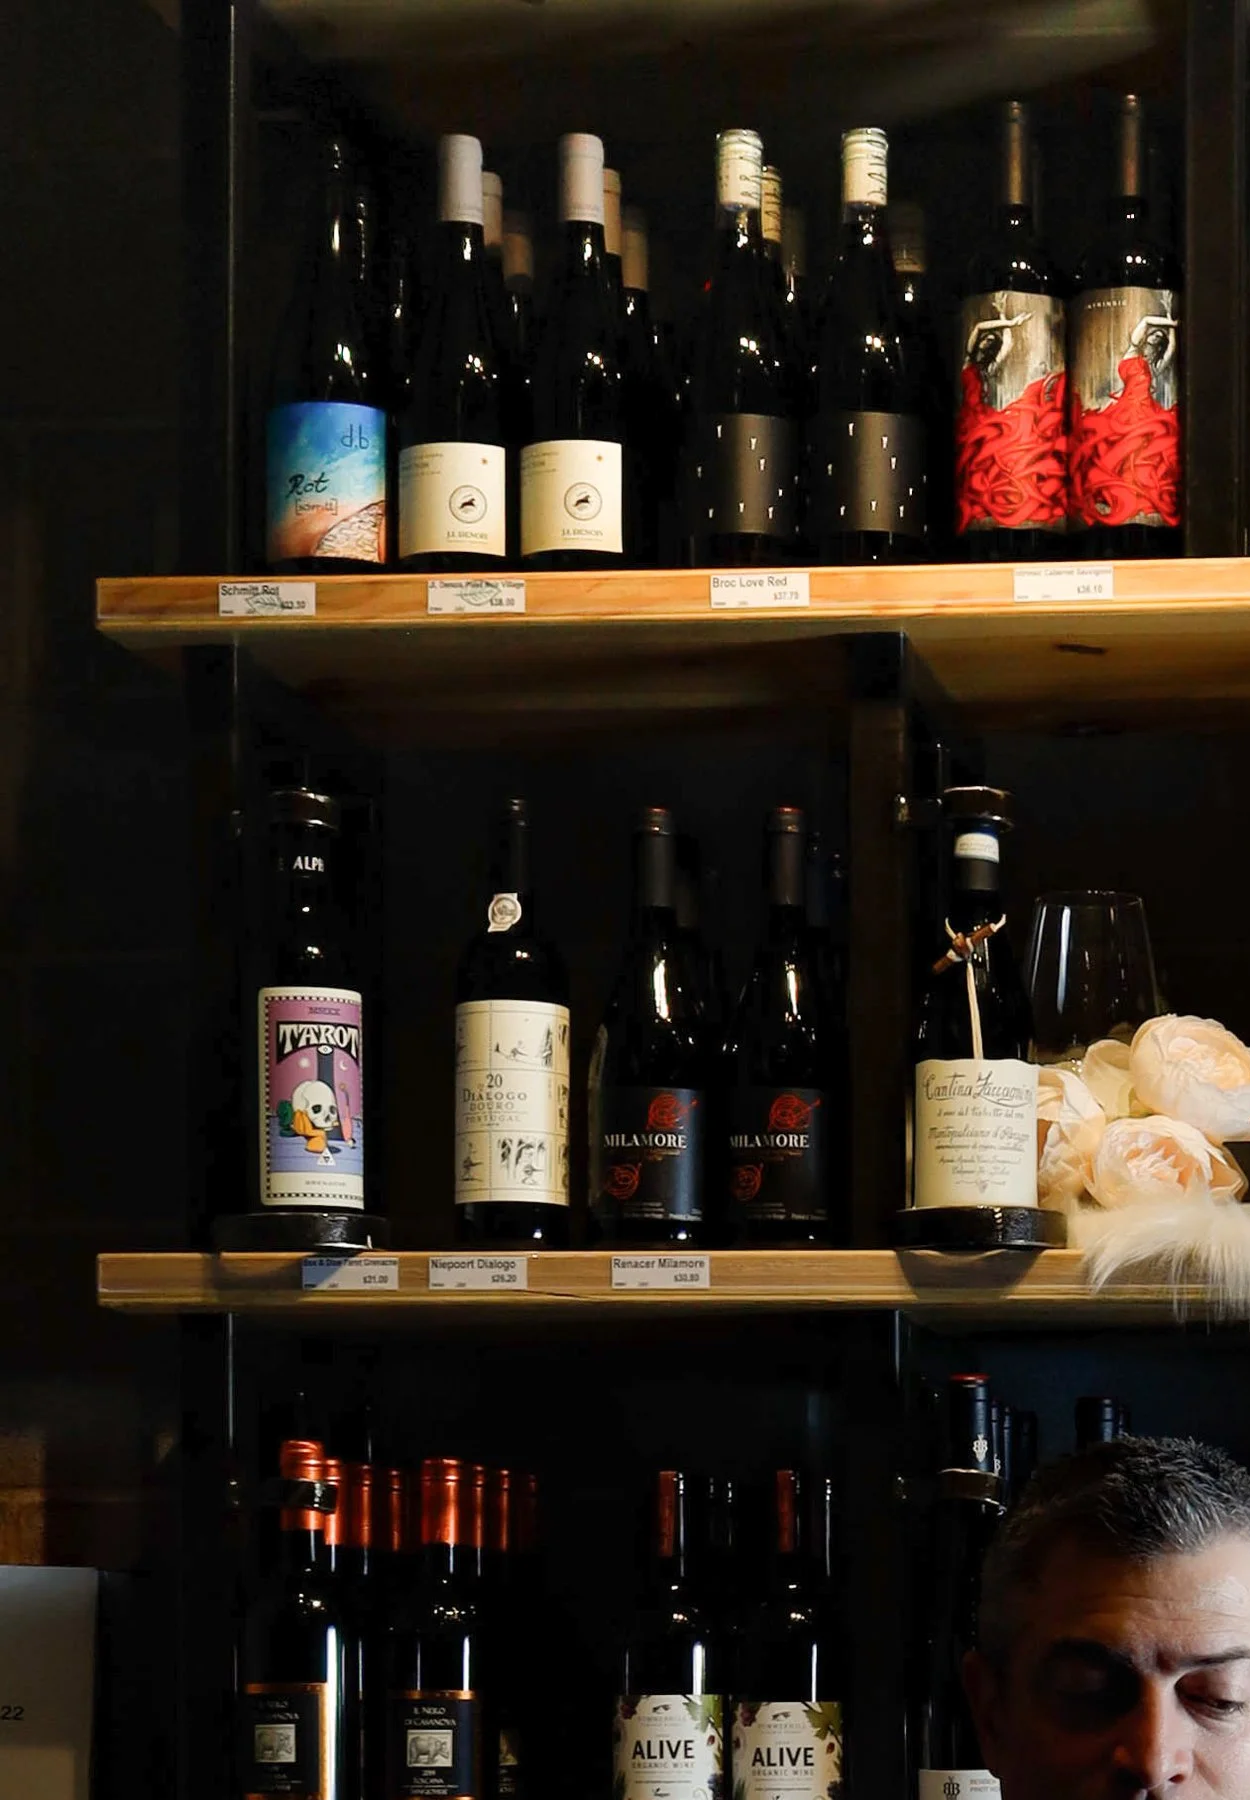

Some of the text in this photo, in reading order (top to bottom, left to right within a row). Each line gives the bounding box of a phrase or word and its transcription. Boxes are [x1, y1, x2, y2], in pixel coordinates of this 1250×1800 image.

[285, 471, 330, 499] Rot
[712, 576, 788, 588] Broc Love Red
[261, 585, 280, 596] Rot
[278, 1022, 360, 1057] TAROT
[486, 1073, 503, 1088] 20
[604, 1133, 688, 1149] MILAMORE
[730, 1133, 810, 1149] MILAMORE
[431, 1259, 516, 1270] Niepoort Dialogo
[613, 1258, 705, 1269] Renacer Milamore
[632, 1740, 695, 1760] ALIVE
[751, 1747, 815, 1767] ALIVE
[632, 1761, 668, 1769] ORGANIC
[752, 1769, 788, 1777] ORGANIC
